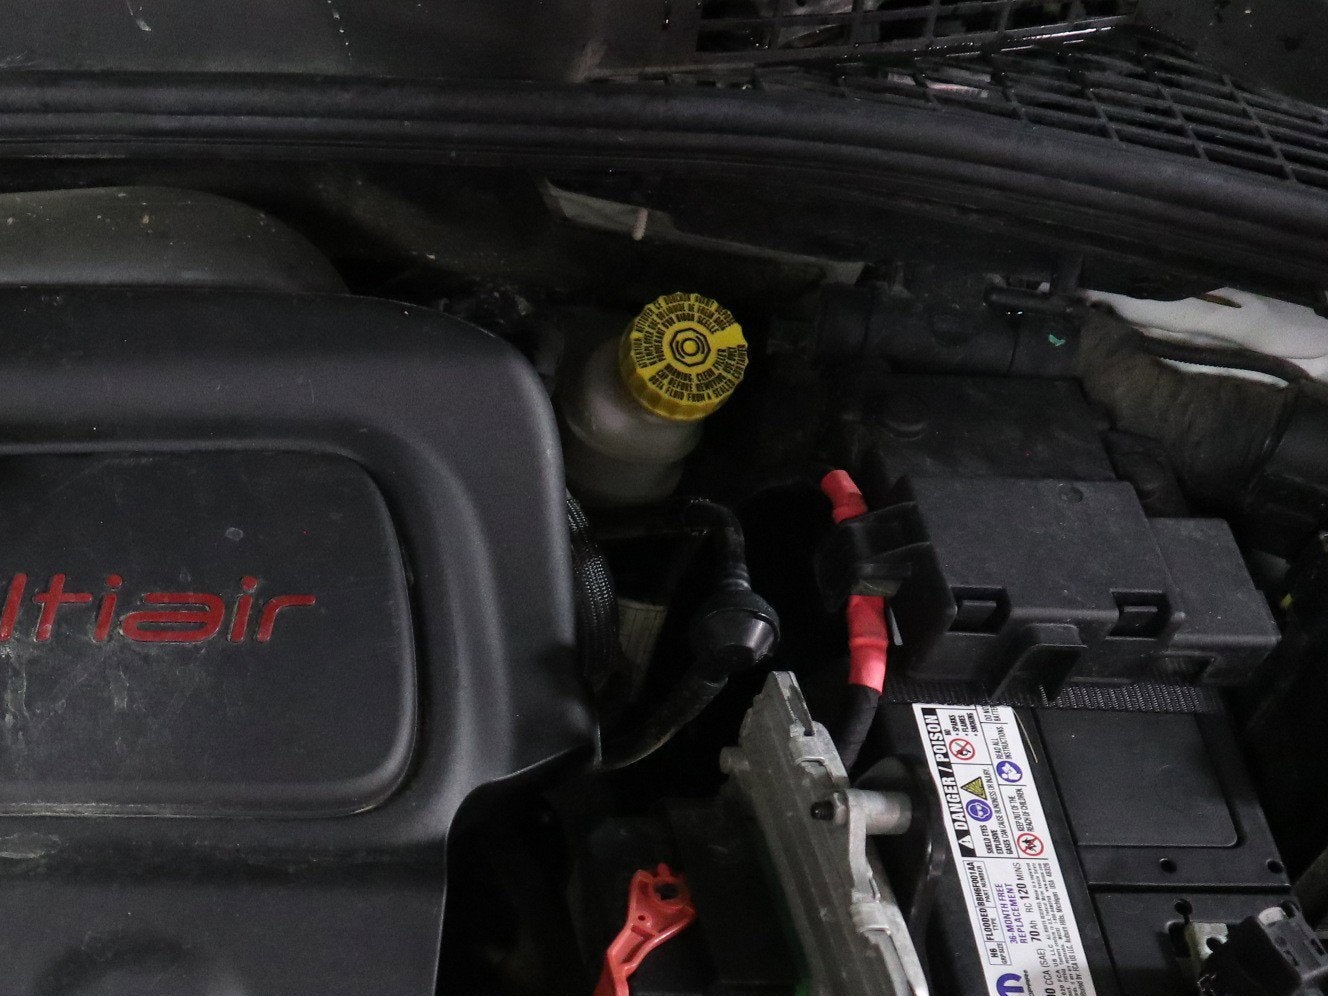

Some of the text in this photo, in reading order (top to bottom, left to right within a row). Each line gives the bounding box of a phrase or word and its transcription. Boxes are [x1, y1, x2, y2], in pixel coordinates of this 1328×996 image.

[950, 715, 959, 731] SPARKS
[959, 715, 967, 732] FLAMES
[968, 713, 978, 732] SMOKING
[926, 715, 948, 761] POISON
[943, 777, 967, 829] DANGER
[990, 791, 1001, 813] BLINDNESS
[996, 815, 1005, 828] CAUSE
[1013, 811, 1021, 820] OUT
[1016, 821, 1024, 831] KEEP
[1025, 818, 1033, 831] REACH
[981, 825, 993, 853] SHIELD EYES
[992, 830, 1003, 854] EXPLOSIVE
[1004, 839, 1013, 854] GASES
[977, 866, 986, 887] NUMBER
[1014, 862, 1024, 880] MINS
[1017, 883, 1029, 899] 120
[996, 884, 1017, 943] 36-MONTH FREE
[1006, 884, 1027, 943] REPLACEMENT
[1025, 903, 1033, 912] RC
[980, 908, 993, 940] FLOODED
[1030, 920, 1038, 929] Ah
[1030, 930, 1041, 941] 70
[1063, 926, 1071, 943] Auburn
[990, 948, 998, 957] H6
[1038, 948, 1049, 968] (SAE)
[1053, 958, 1058, 967] US
[1043, 970, 1053, 985] CCA
